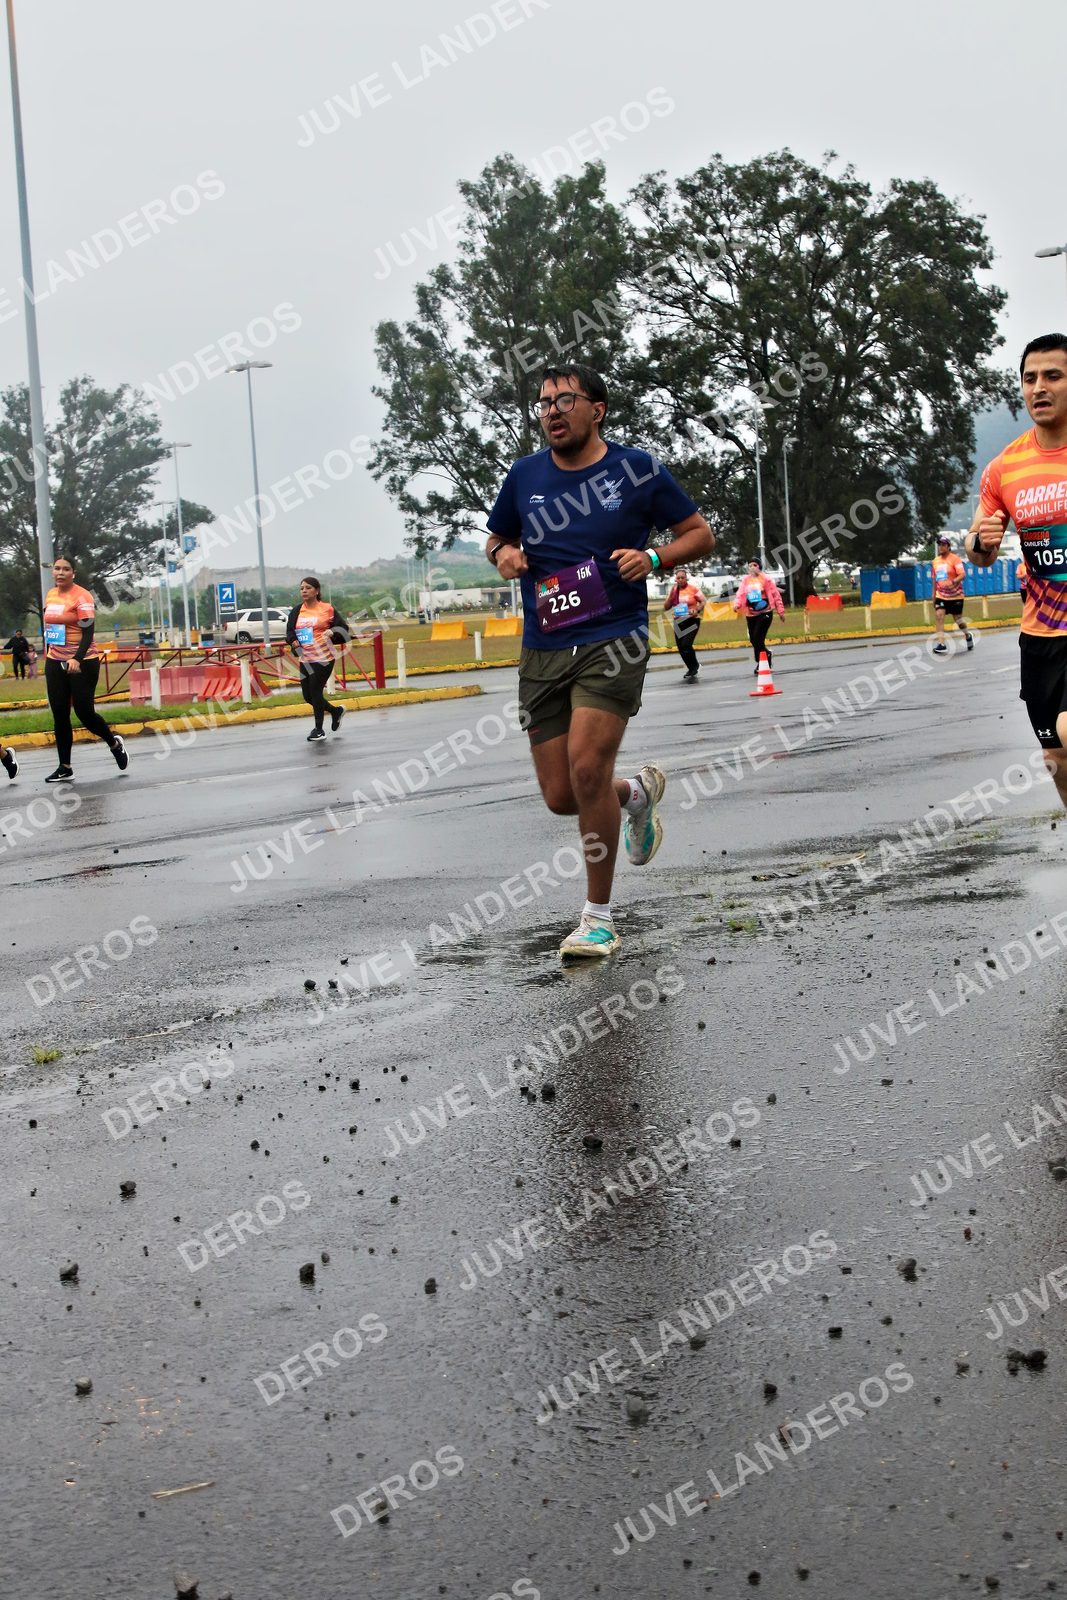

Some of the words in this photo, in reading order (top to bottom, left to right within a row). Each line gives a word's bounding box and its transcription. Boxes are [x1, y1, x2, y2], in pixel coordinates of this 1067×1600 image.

[1015, 481, 1067, 508] CARRE
[1034, 548, 1067, 566] 105
[549, 591, 581, 614] 226
